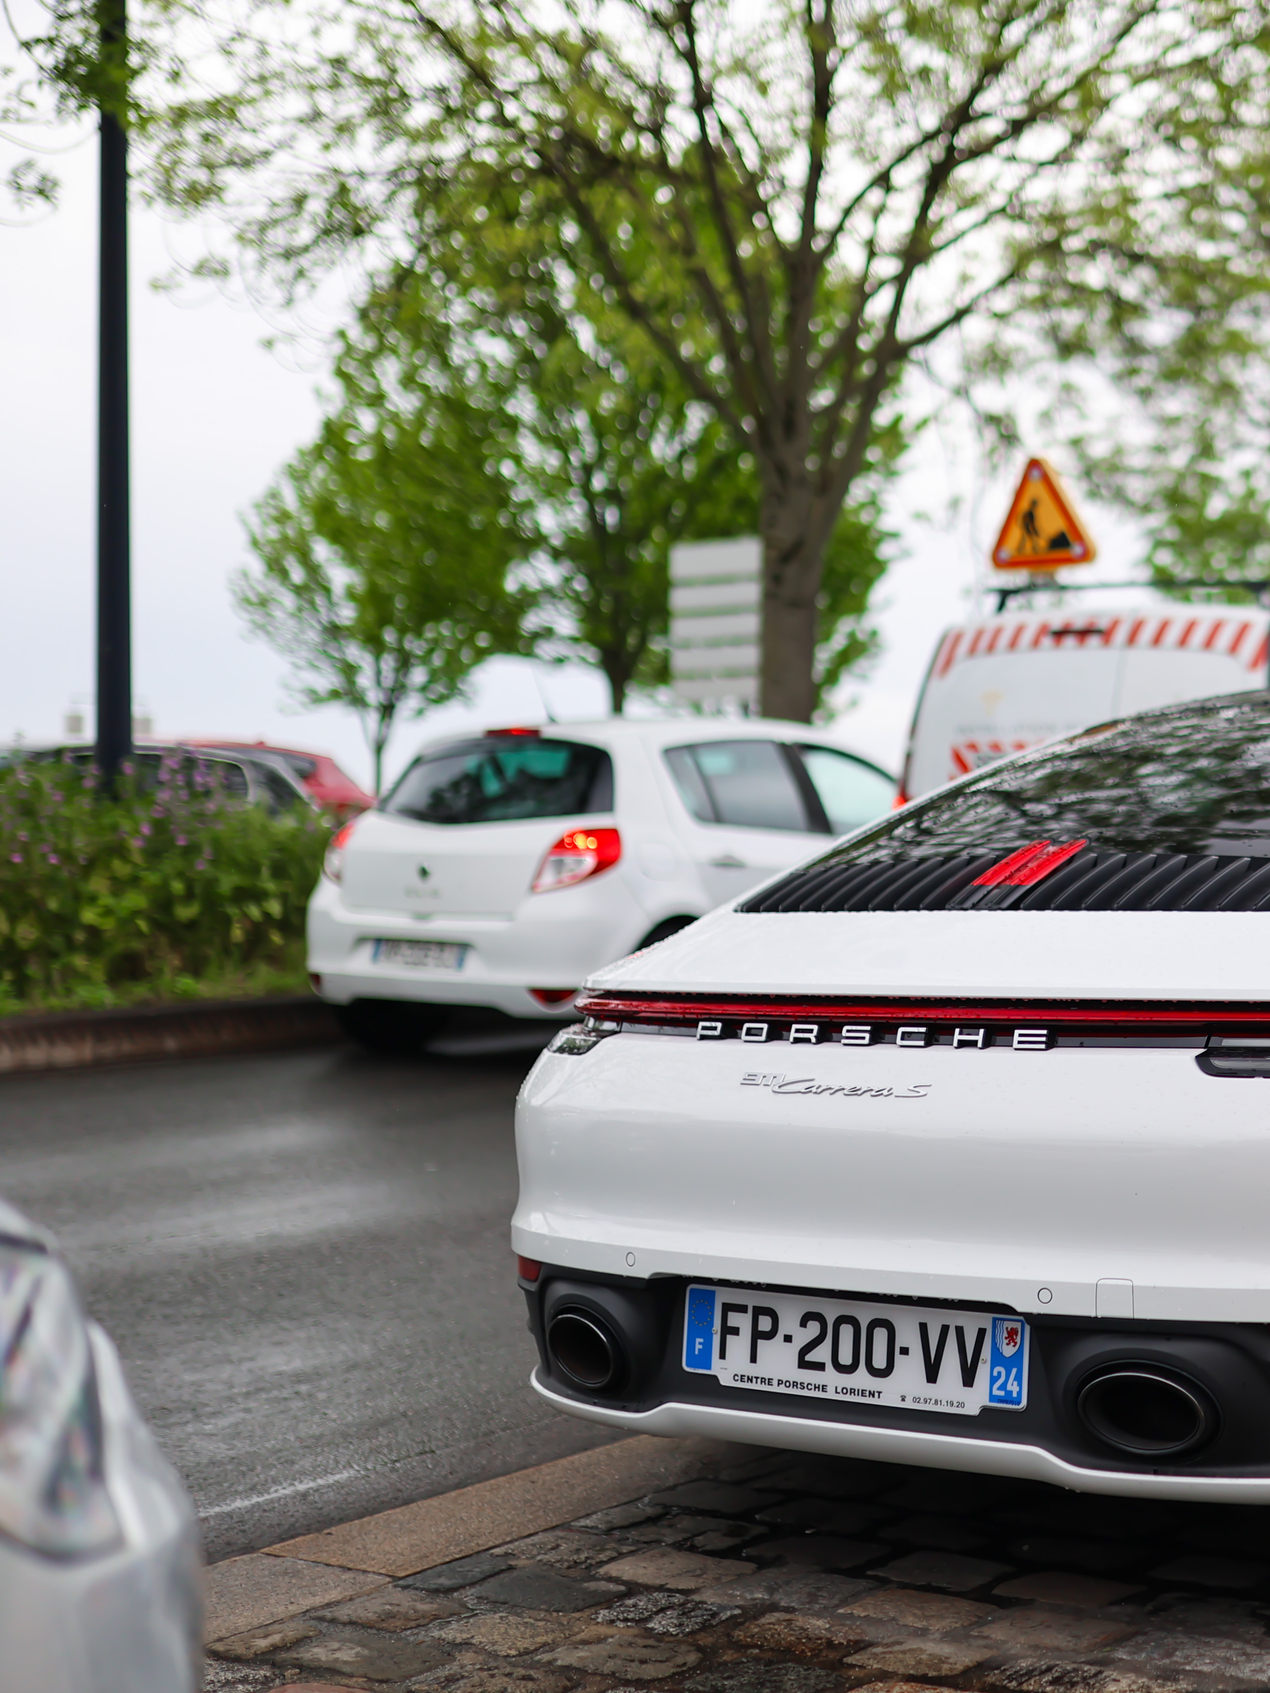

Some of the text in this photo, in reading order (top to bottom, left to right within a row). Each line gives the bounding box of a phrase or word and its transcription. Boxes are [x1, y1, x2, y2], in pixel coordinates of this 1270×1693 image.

[696, 1021, 1048, 1049] PORSCHE
[740, 1071, 932, 1098] 911 Carrera S
[694, 1338, 704, 1355] F
[719, 1302, 987, 1388] FP-200-VV
[732, 1373, 883, 1399] CENTRE PORSCHE LORIENT
[992, 1366, 1020, 1397] 24
[912, 1396, 965, 1409] 02.97.81.19.20
